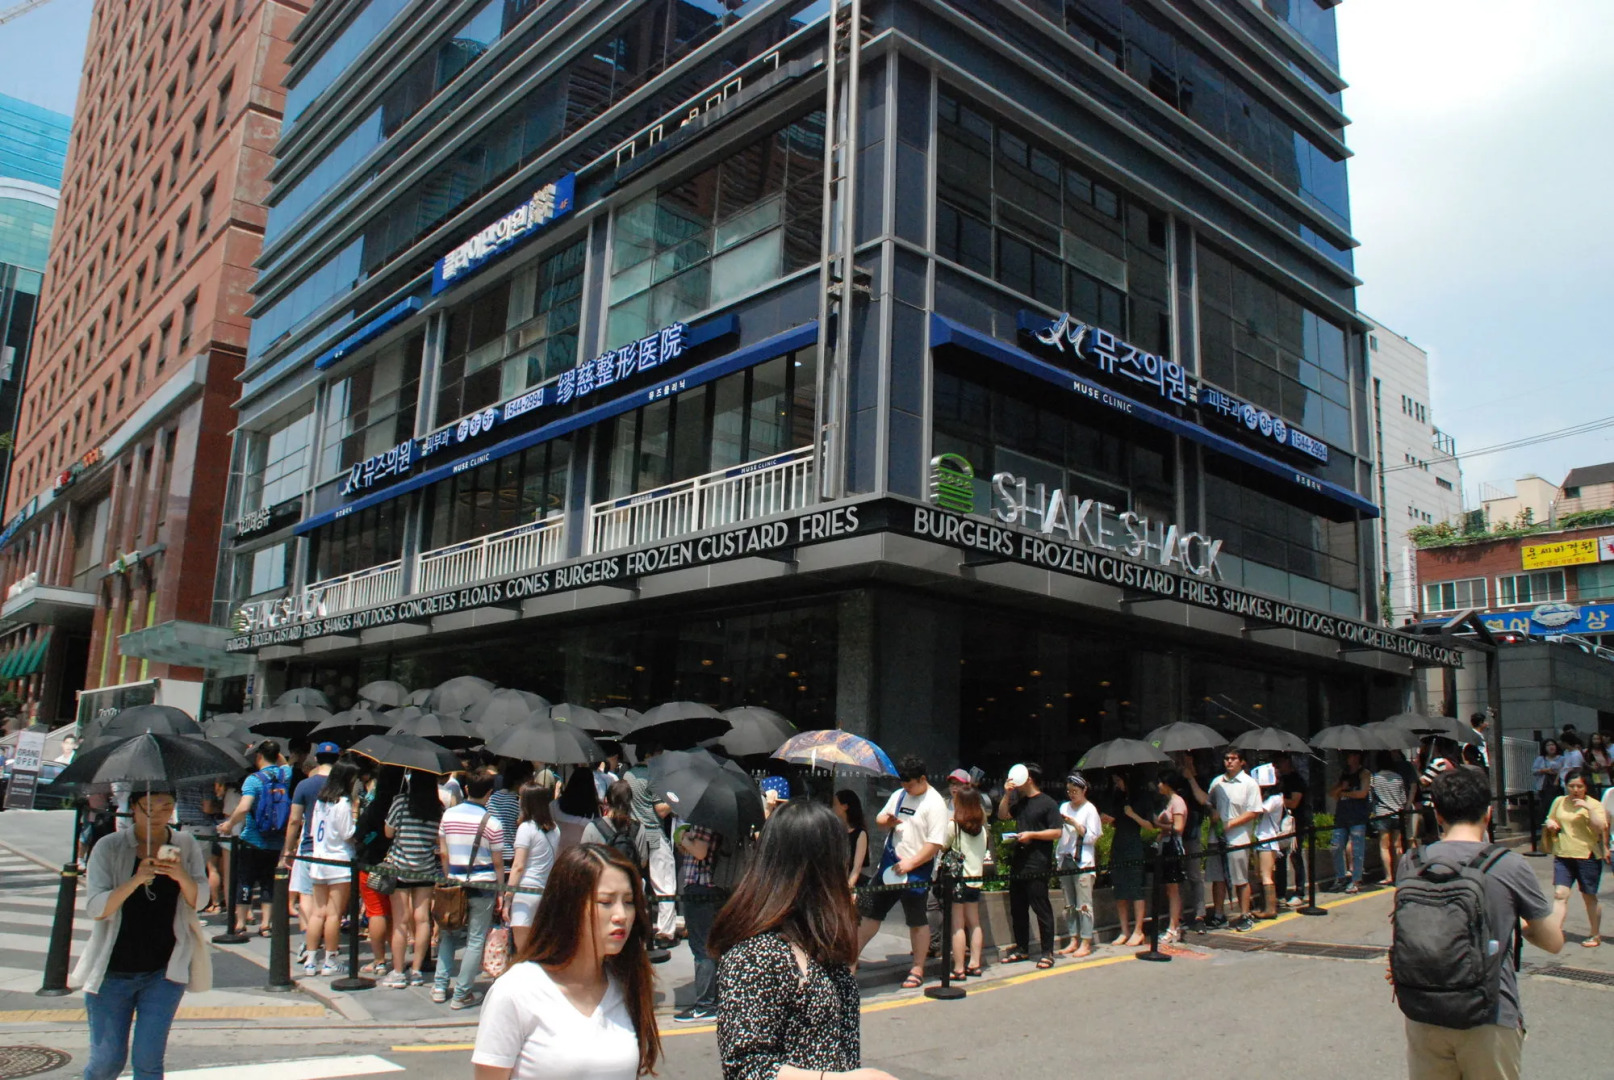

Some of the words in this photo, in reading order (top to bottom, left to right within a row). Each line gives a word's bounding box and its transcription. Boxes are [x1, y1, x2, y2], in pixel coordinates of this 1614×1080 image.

[556, 324, 683, 404] 缪慈整形医院
[1073, 380, 1100, 400] MUSE
[1102, 394, 1132, 414] CLINIC
[1092, 328, 1187, 406] 뮤즈의원
[1208, 389, 1241, 423] 피부과
[1292, 430, 1327, 461] 1544-2994
[363, 440, 413, 488] 뮤즈의원
[427, 429, 450, 453] 피부과
[505, 389, 544, 419] 1544-2994
[453, 462, 469, 474] MUSE
[470, 453, 490, 467] CLINIC
[741, 464, 757, 474] MUSE
[758, 459, 777, 469] CLINIC
[991, 471, 1116, 551] SHAKE
[1119, 511, 1224, 581] SHACK
[226, 637, 250, 652] BURGERS
[250, 633, 272, 647] FROZEN
[274, 626, 301, 643] CUSTARD
[303, 622, 321, 637] FRIES
[324, 615, 351, 633] SHAKES
[353, 612, 371, 628] HOT
[372, 605, 395, 624] DOGS
[400, 593, 456, 620] CONCRETES
[460, 583, 501, 607] FLOATS
[506, 572, 549, 598] CONES
[555, 558, 619, 589] BURGERS
[626, 541, 693, 575] FROZEN
[698, 522, 788, 560] CUSTARD
[799, 506, 859, 541] FRIES
[914, 507, 1014, 555] BURGERS
[1021, 536, 1097, 577] FROZEN
[1100, 557, 1175, 595] CUSTARD
[1179, 578, 1218, 606] FRIES
[1222, 591, 1272, 620] SHAKES
[1276, 605, 1302, 628] HOT
[1303, 611, 1335, 636] DOGS
[1337, 622, 1397, 650] CONCRETES
[1398, 636, 1432, 659] FLOATS
[1433, 646, 1462, 666] CONES
[244, 600, 283, 632] SHAKE
[282, 588, 327, 623] SHACK
[1586, 610, 1610, 630] 상
[15, 757, 39, 766] OPEN
[317, 820, 325, 843] 6
